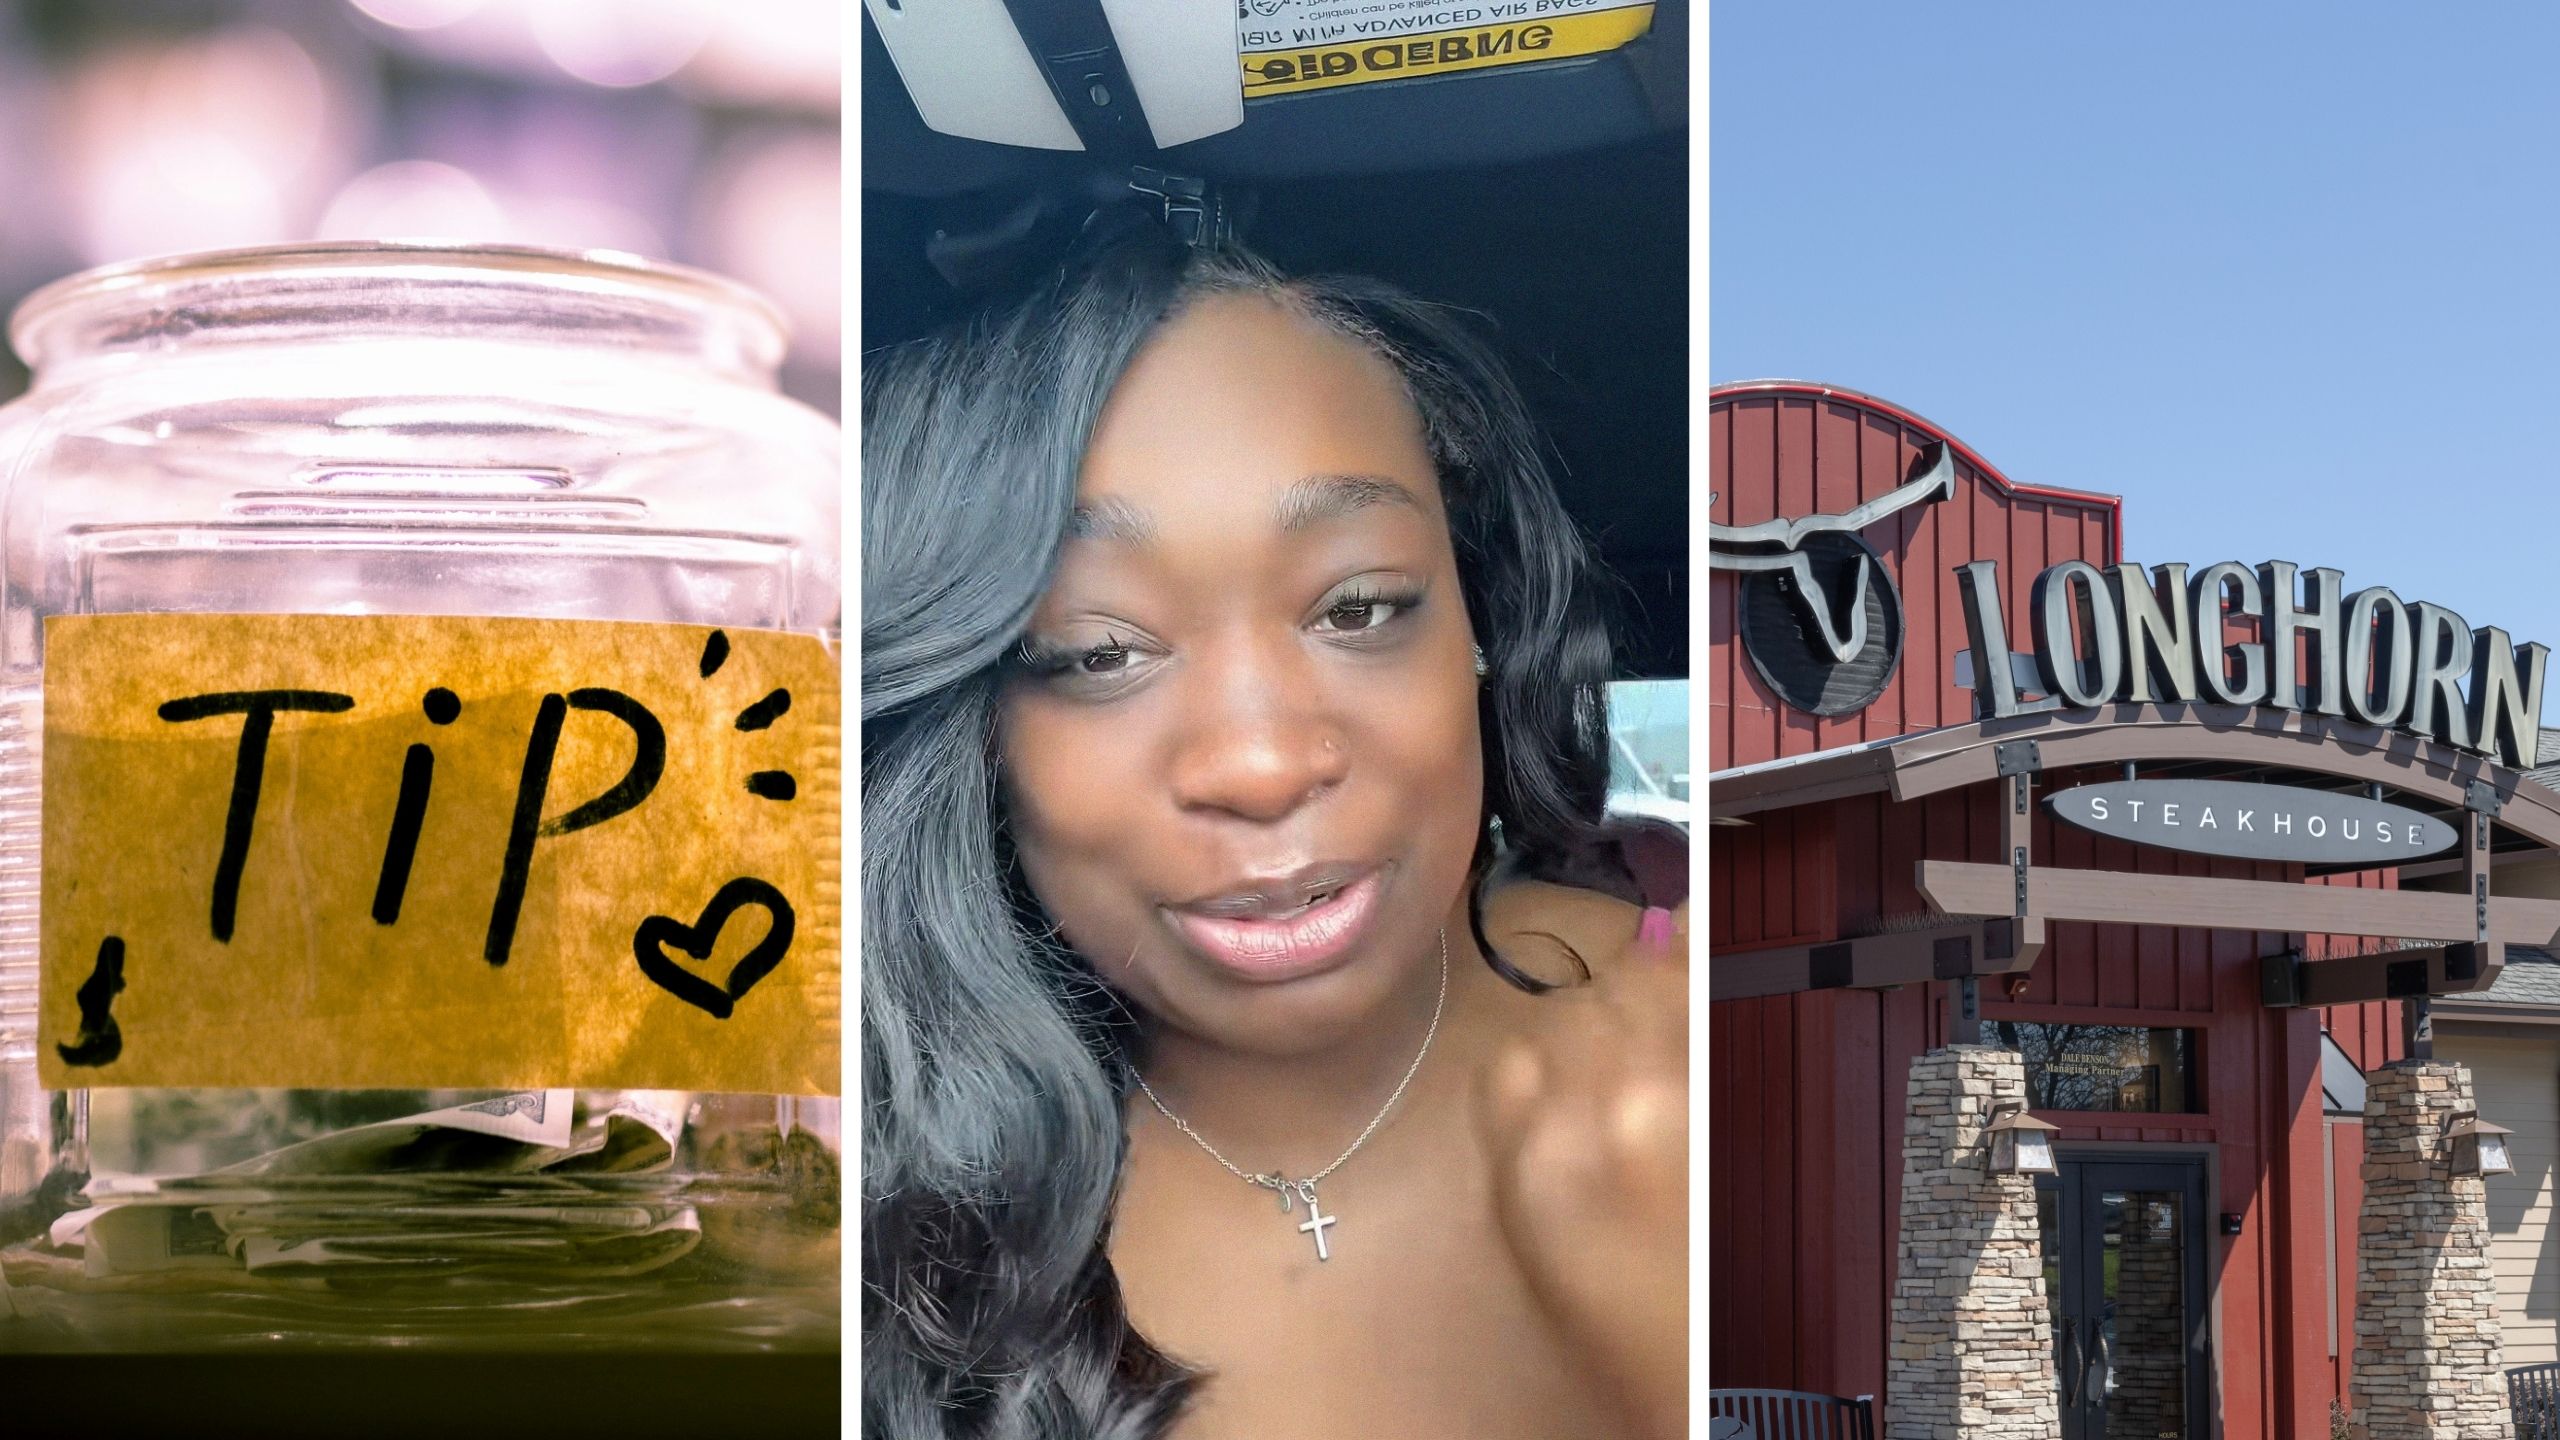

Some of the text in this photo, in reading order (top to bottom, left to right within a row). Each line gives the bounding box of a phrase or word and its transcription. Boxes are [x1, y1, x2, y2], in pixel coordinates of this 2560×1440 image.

[1953, 559, 2551, 770] LONGHORN
[2091, 797, 2425, 846] STEAKHOUSE
[2045, 1063, 2124, 1076] Managing Partner
[2061, 1053, 2080, 1062] DALE
